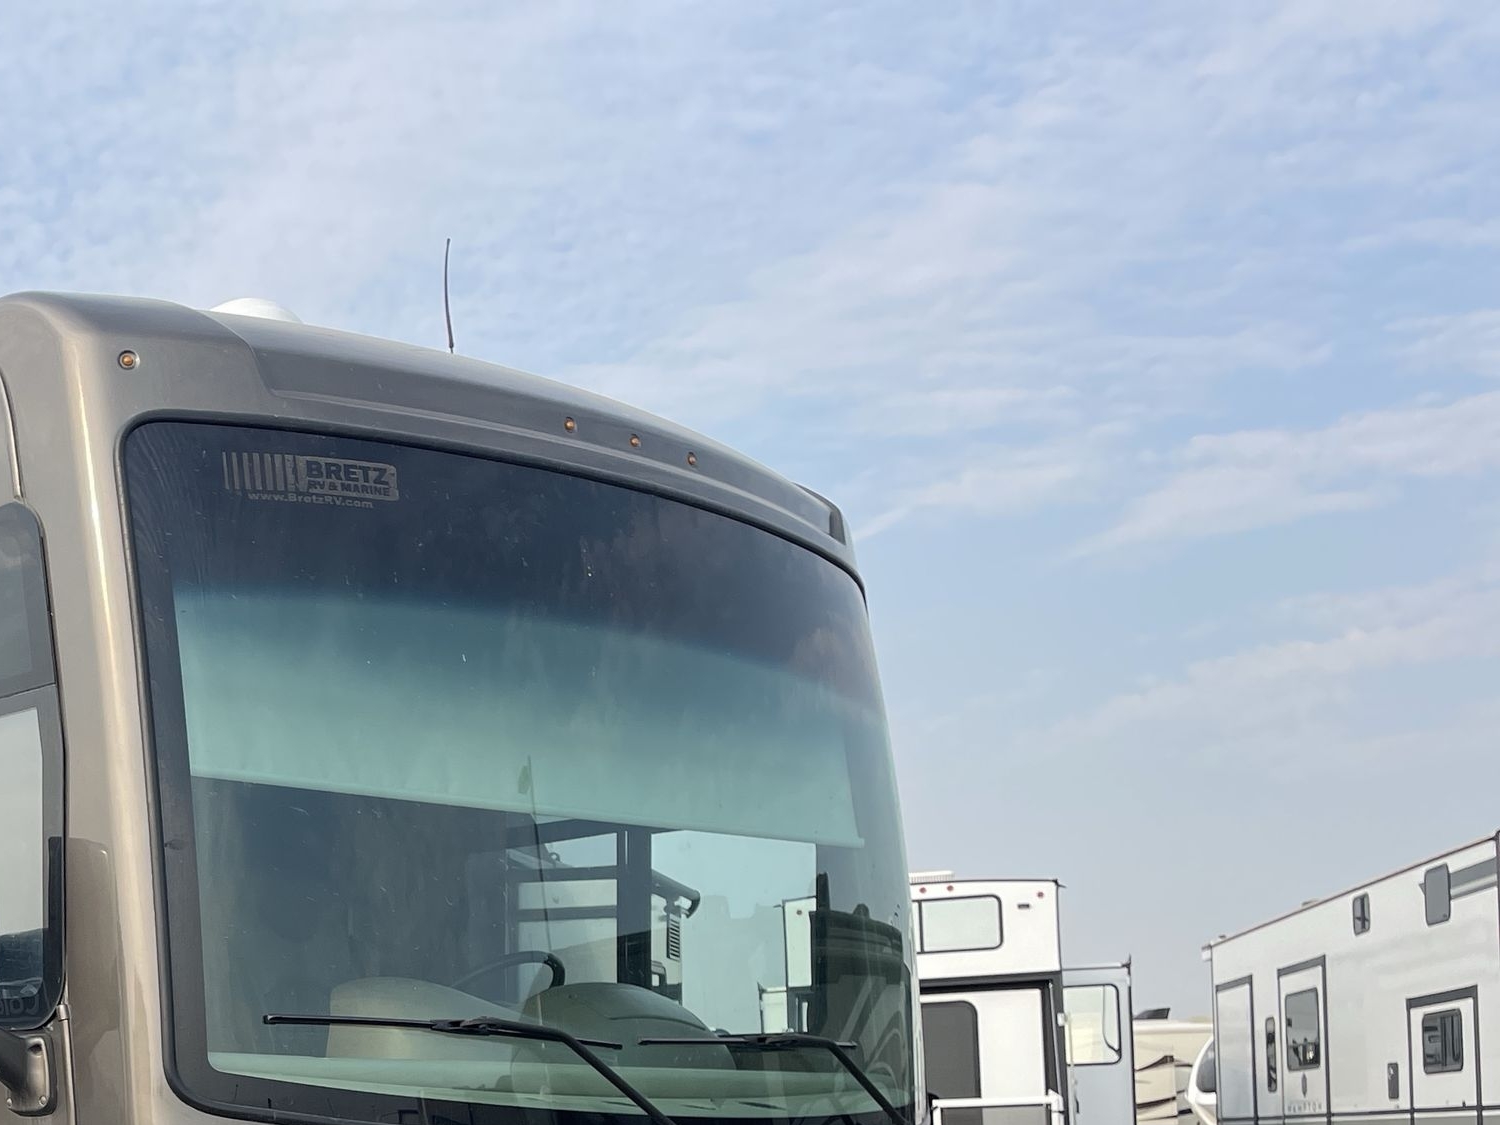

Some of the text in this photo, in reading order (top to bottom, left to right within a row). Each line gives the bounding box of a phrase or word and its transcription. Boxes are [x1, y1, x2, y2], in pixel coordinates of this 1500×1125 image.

[306, 459, 392, 485] BRETZ
[308, 480, 391, 497] RV & MARINE
